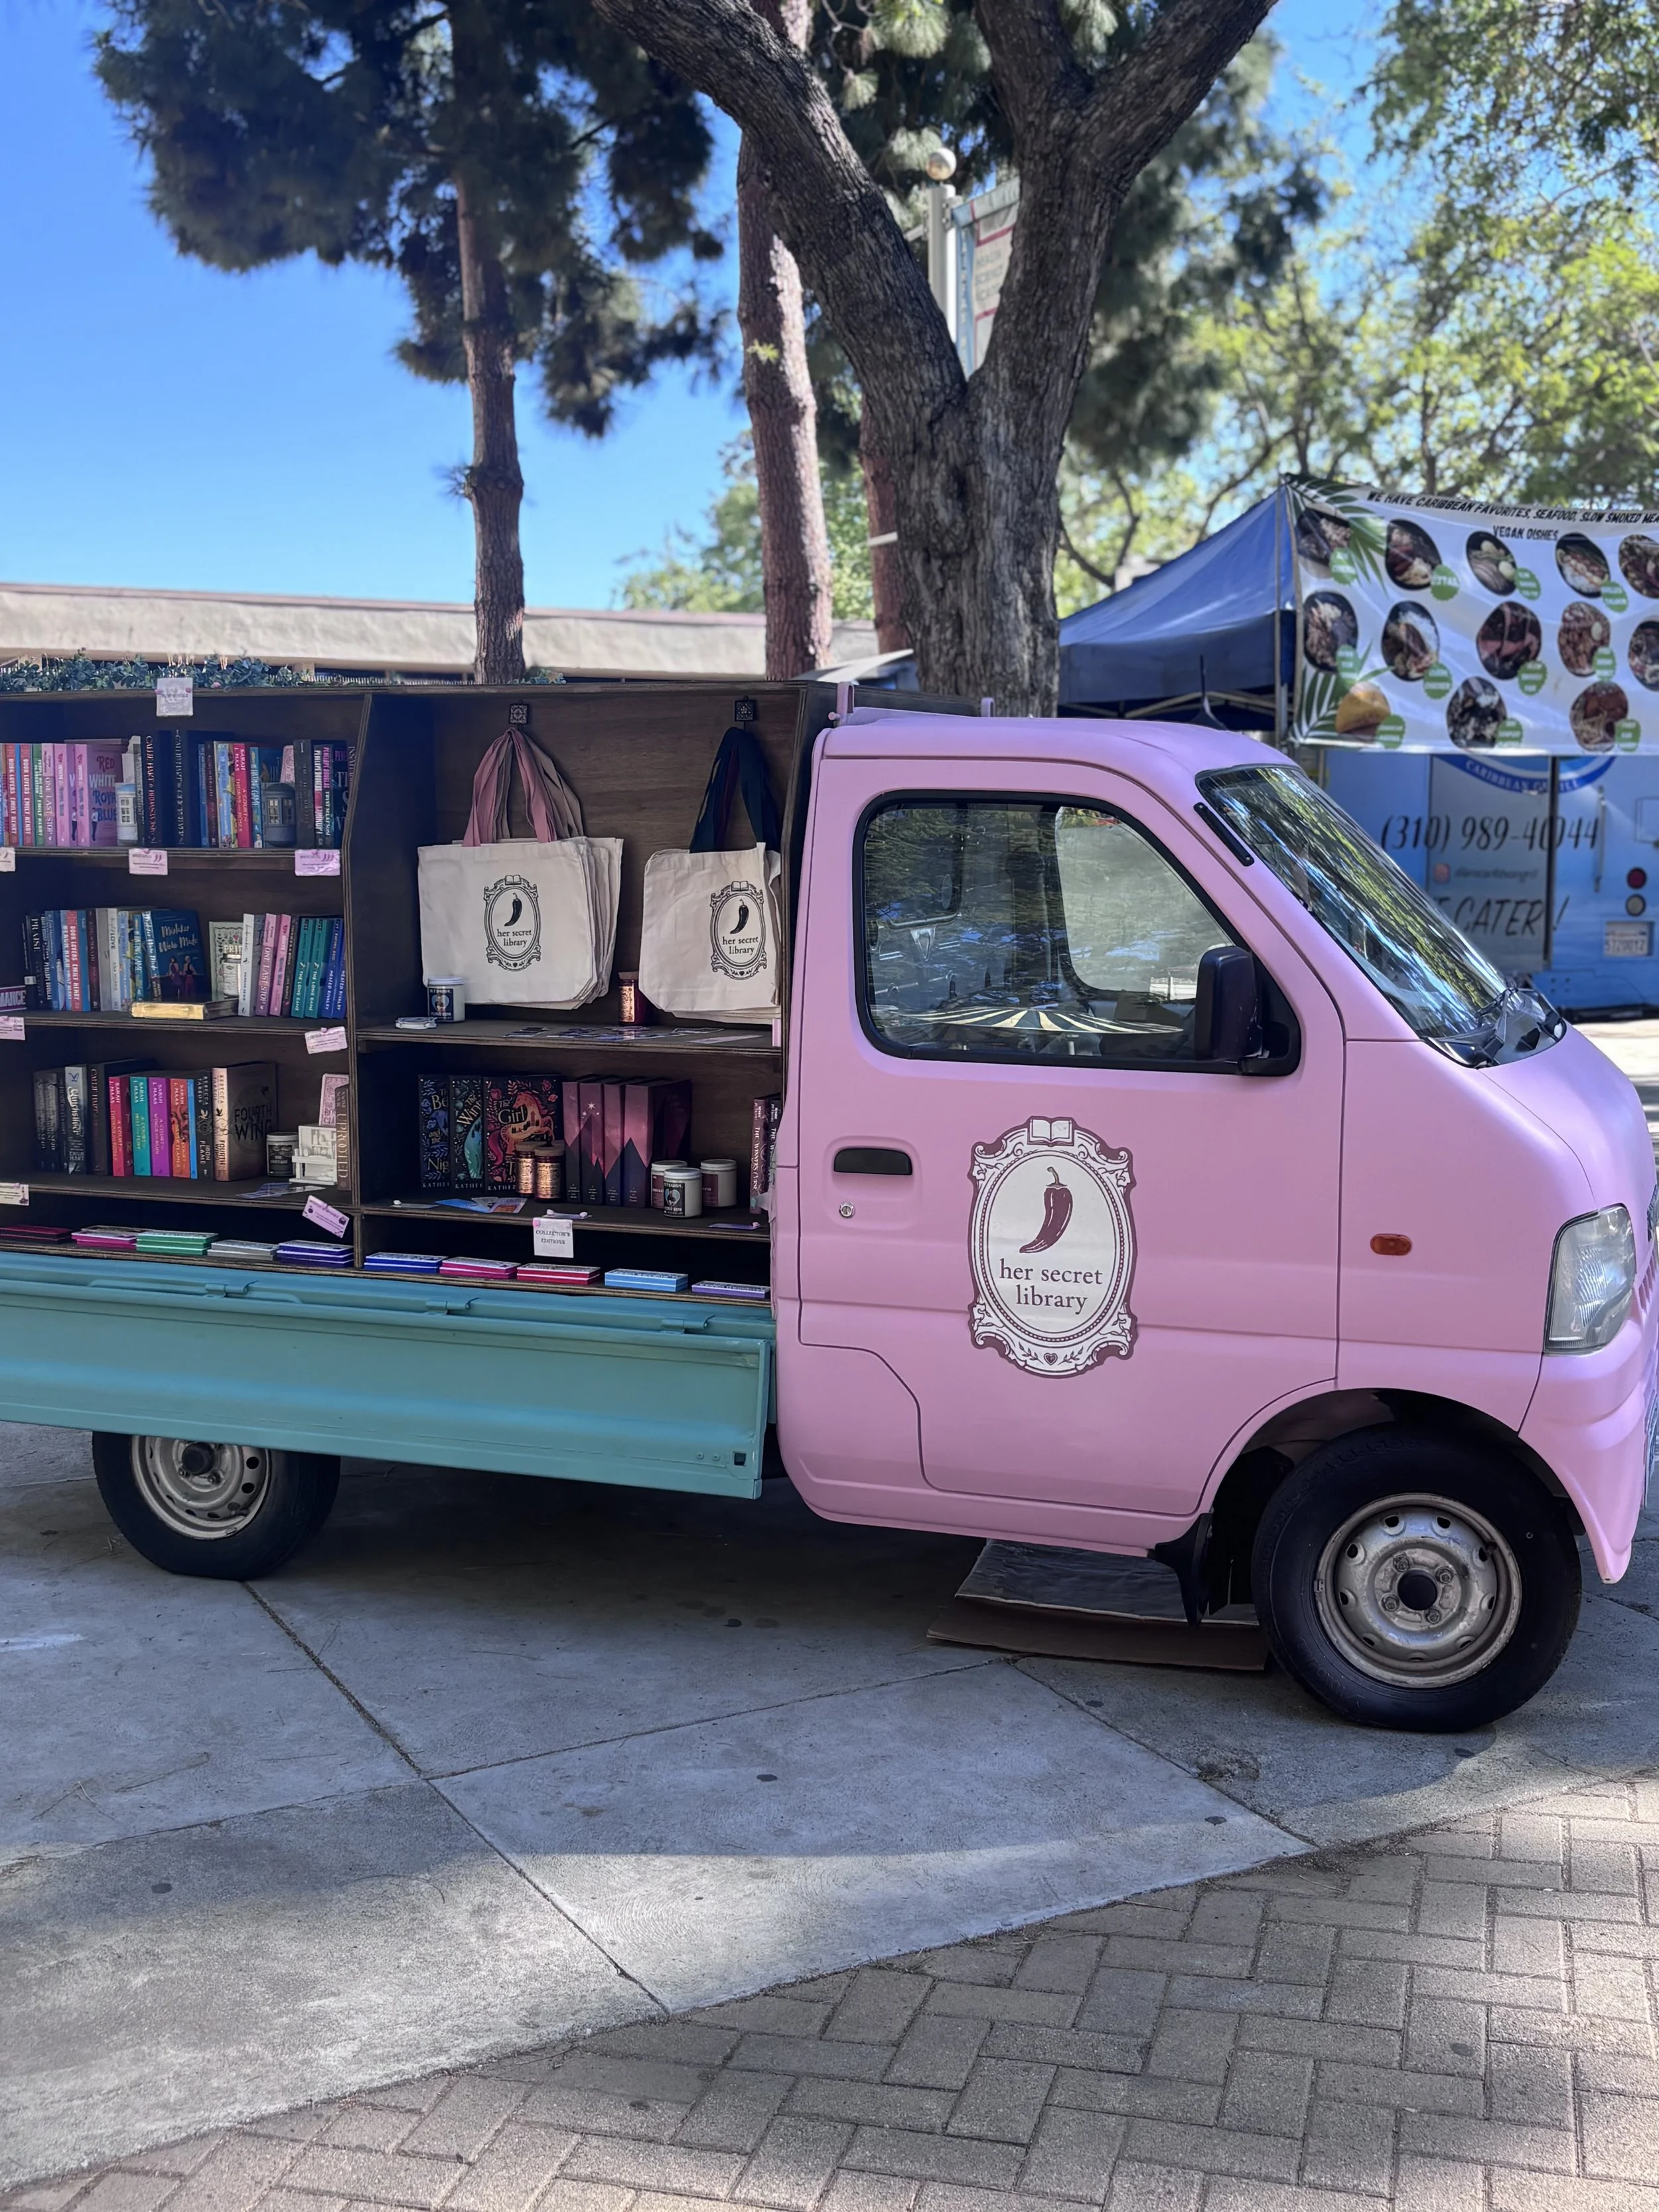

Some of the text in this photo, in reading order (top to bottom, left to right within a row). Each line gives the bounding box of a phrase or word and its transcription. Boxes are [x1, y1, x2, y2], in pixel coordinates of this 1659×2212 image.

[1367, 491, 1659, 524] WE HAVE CARIBBEAN FAVORITES, SEAFOOD, SLOW SMOKED MEA
[1493, 525, 1559, 541] VEGAN DISHES
[96, 755, 115, 772] RED
[1465, 759, 1530, 791] CARIBBEAN
[92, 790, 116, 806] ROYA
[1380, 814, 1600, 855] (310) 989-4044
[179, 934, 198, 948] Made
[503, 938, 528, 948] library
[722, 936, 758, 945] her secret
[729, 946, 755, 956] library
[431, 1094, 449, 1110] Be
[498, 1097, 513, 1108] The
[234, 1104, 272, 1122] FOURTH
[457, 1100, 482, 1126] Win
[498, 1106, 526, 1125] Girl
[234, 1121, 272, 1142] WING
[337, 1114, 348, 1178] UPROOTED
[999, 1258, 1103, 1285] her secret
[1016, 1285, 1088, 1315] library
